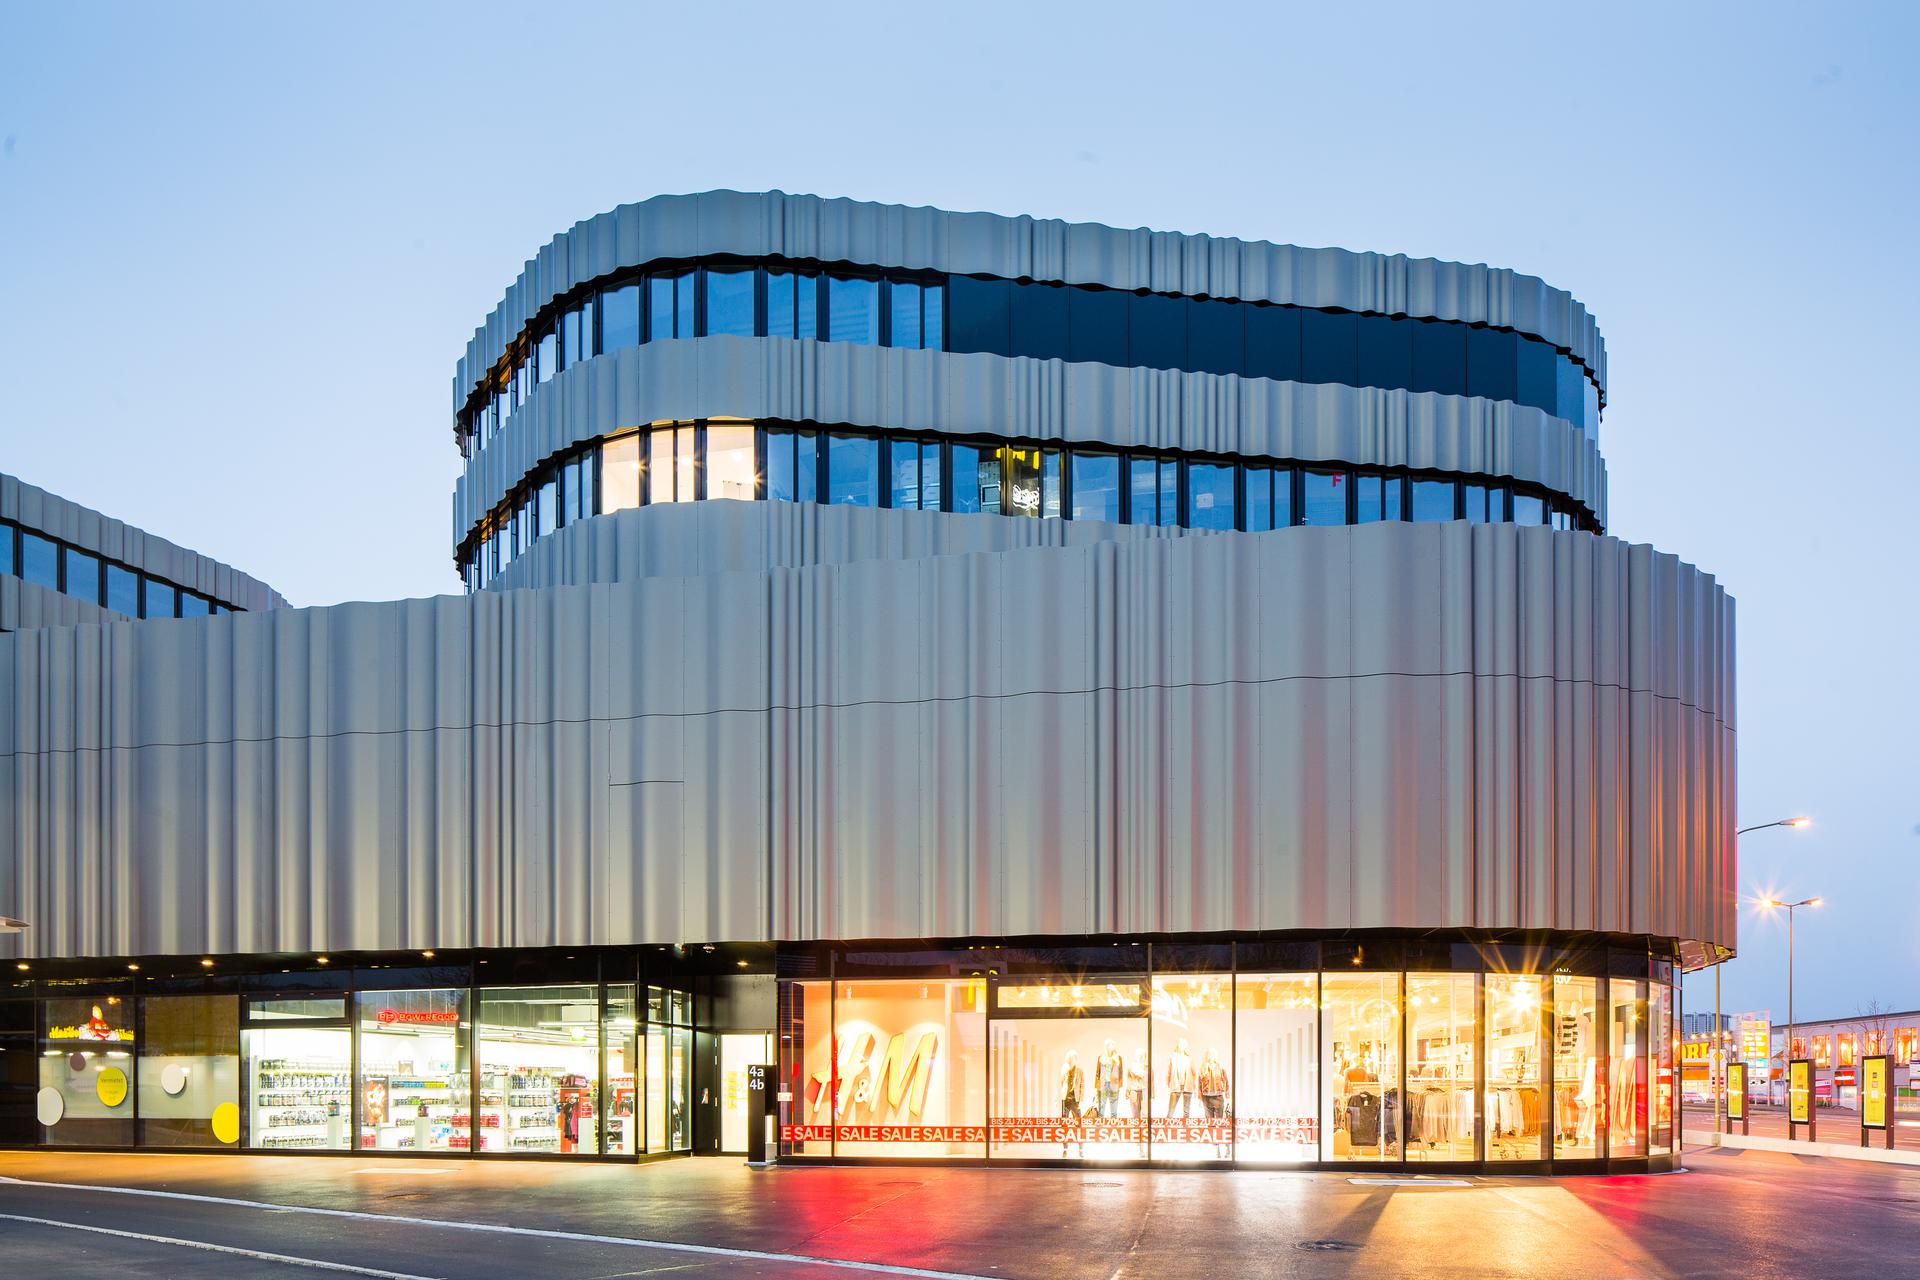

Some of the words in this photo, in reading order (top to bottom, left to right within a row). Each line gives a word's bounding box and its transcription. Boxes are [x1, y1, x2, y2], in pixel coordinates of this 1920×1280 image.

[749, 1066, 765, 1077] 4a
[811, 1031, 938, 1117] H&M
[749, 1079, 765, 1090] 4b
[1081, 1118, 1093, 1126] BIS
[1095, 1118, 1105, 1126] ZU
[1107, 1118, 1124, 1126] 70%
[1127, 1118, 1139, 1126] BIS
[1153, 1118, 1164, 1126] ZU
[1166, 1118, 1183, 1126] 70%
[1186, 1118, 1198, 1126] BIS
[1200, 1118, 1210, 1126] ZU
[1212, 1118, 1230, 1126] 70%
[794, 1127, 832, 1140] SALE
[840, 1127, 878, 1141] SALE
[881, 1128, 920, 1141] SALE
[923, 1128, 962, 1141] SALE
[1011, 1128, 1052, 1142] SALE
[1055, 1128, 1096, 1142] SALE
[1098, 1128, 1139, 1142] SALE
[1189, 1128, 1232, 1143] SALE
